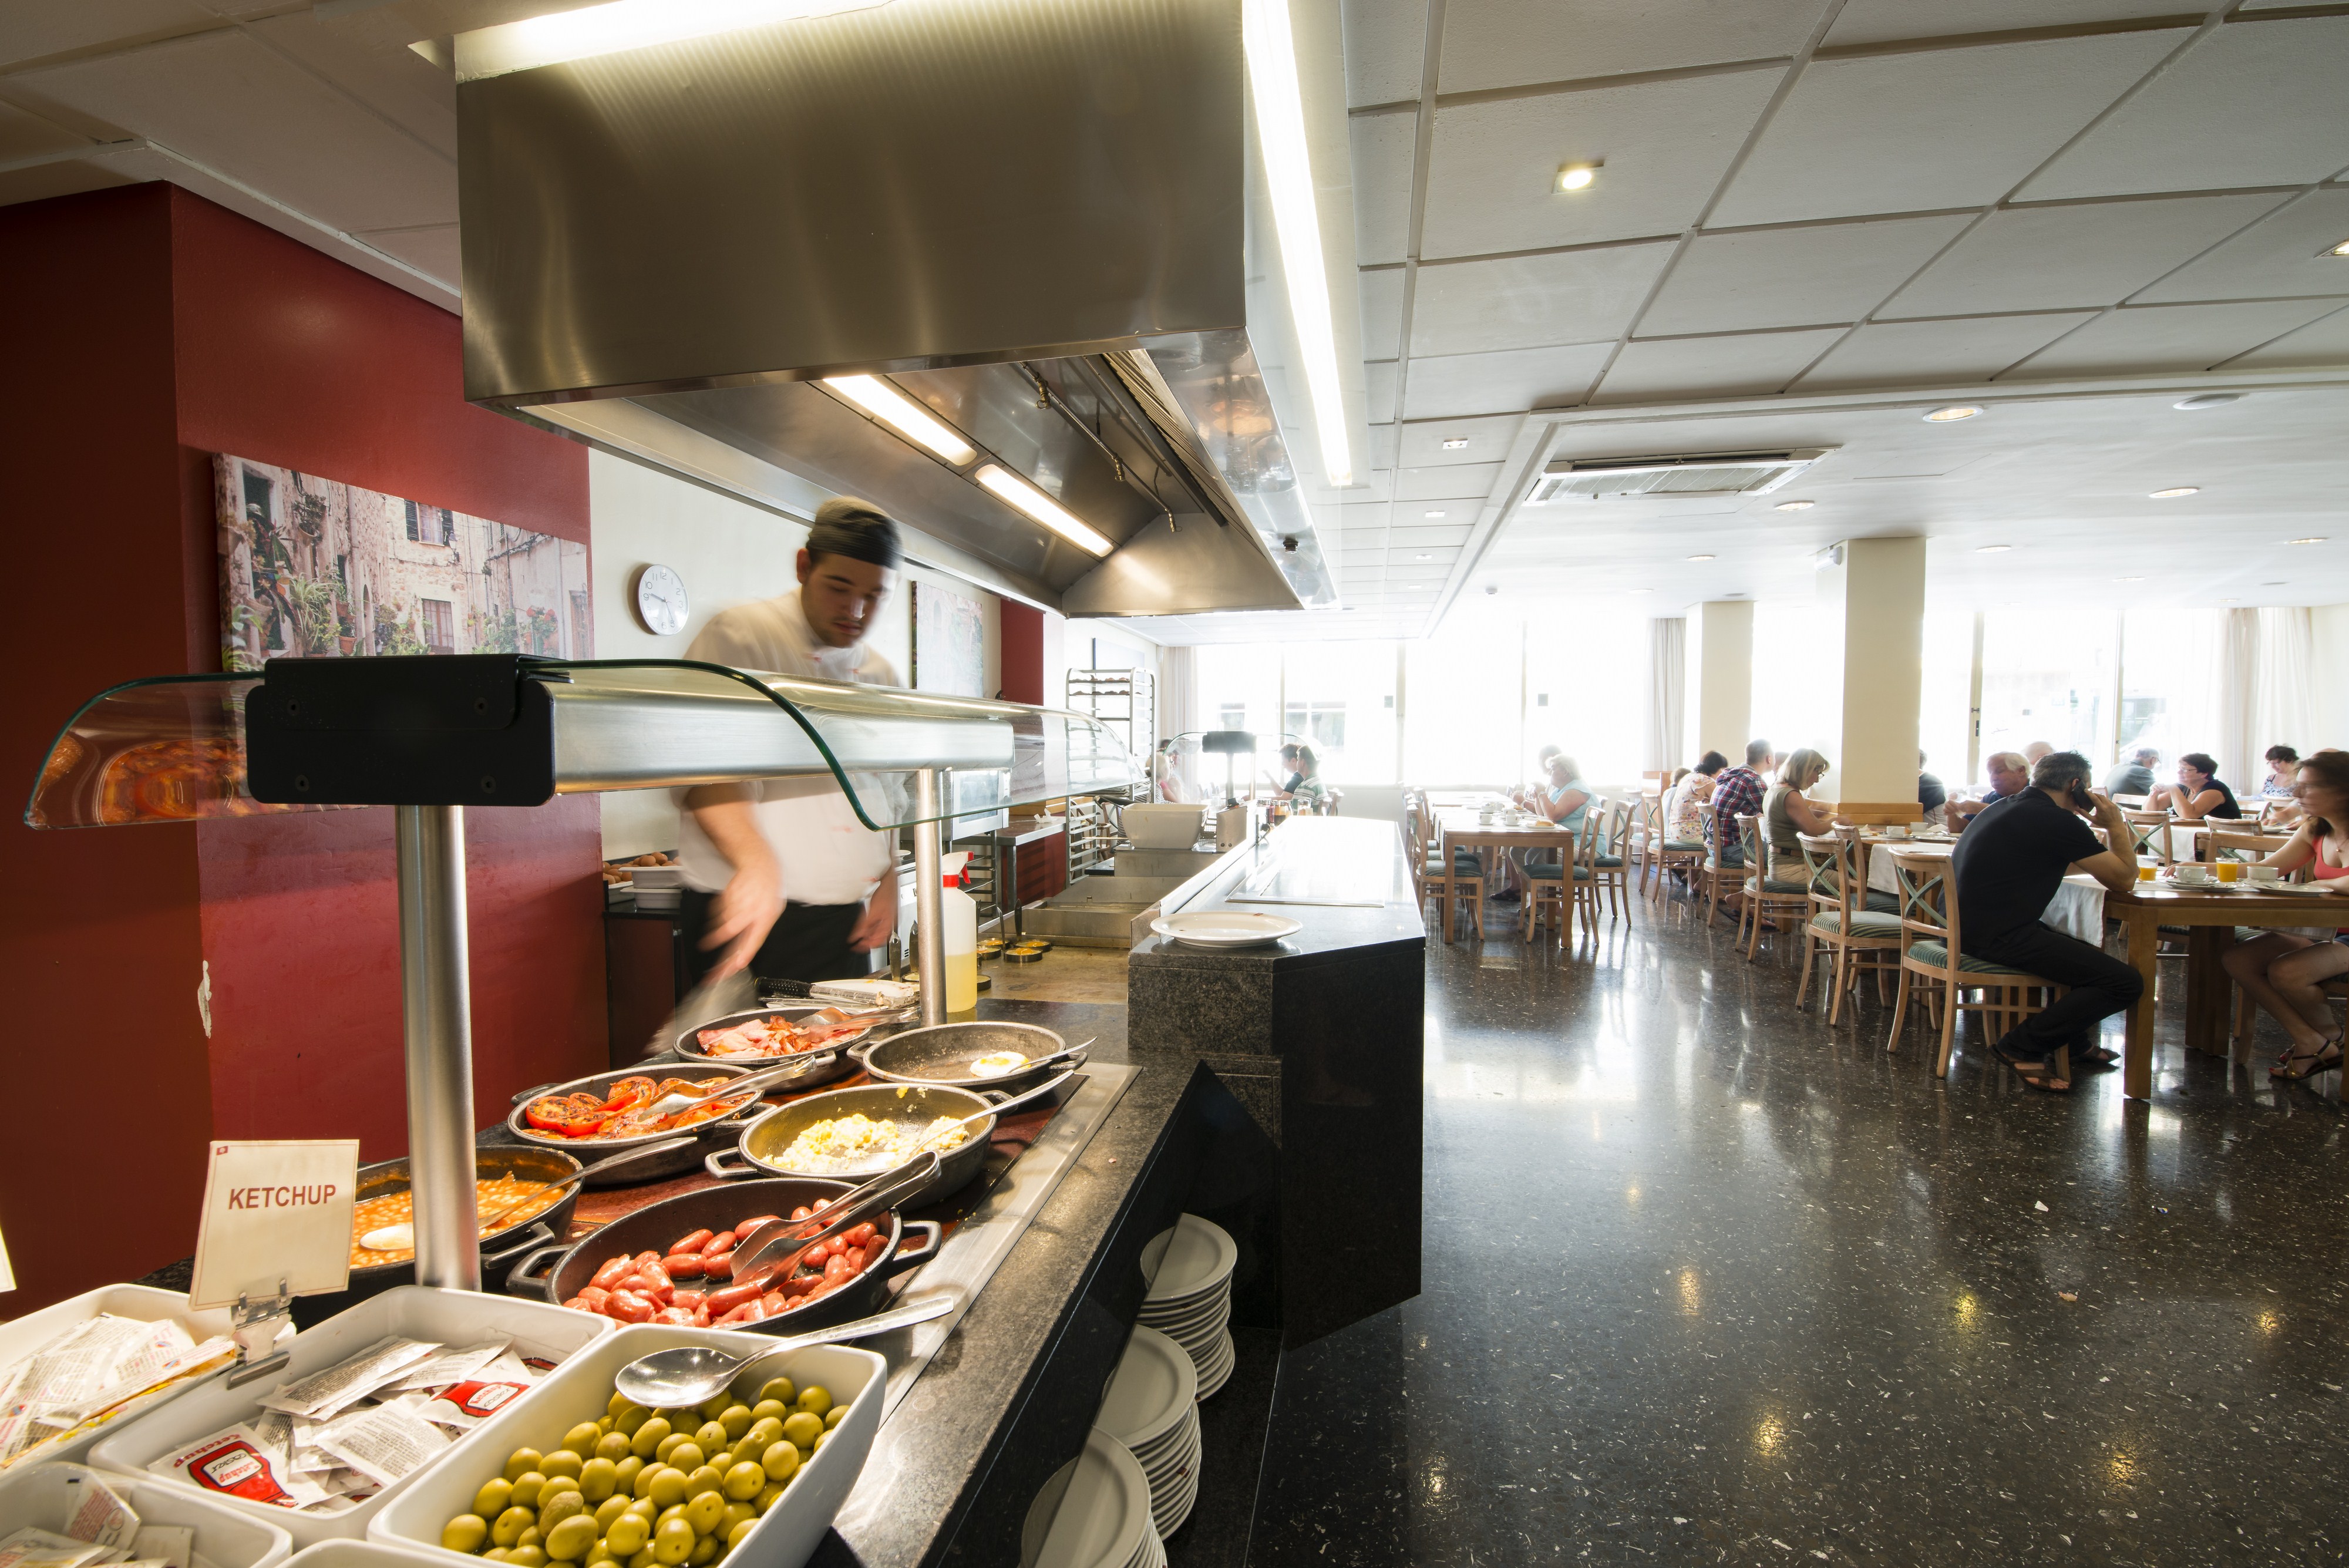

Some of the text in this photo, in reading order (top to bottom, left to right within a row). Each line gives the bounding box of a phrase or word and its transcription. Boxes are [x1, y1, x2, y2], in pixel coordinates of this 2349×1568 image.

[660, 571, 667, 580] 12
[645, 581, 652, 589] 10
[228, 1185, 336, 1209] KETCHUP
[173, 1434, 241, 1468] Ketchup
